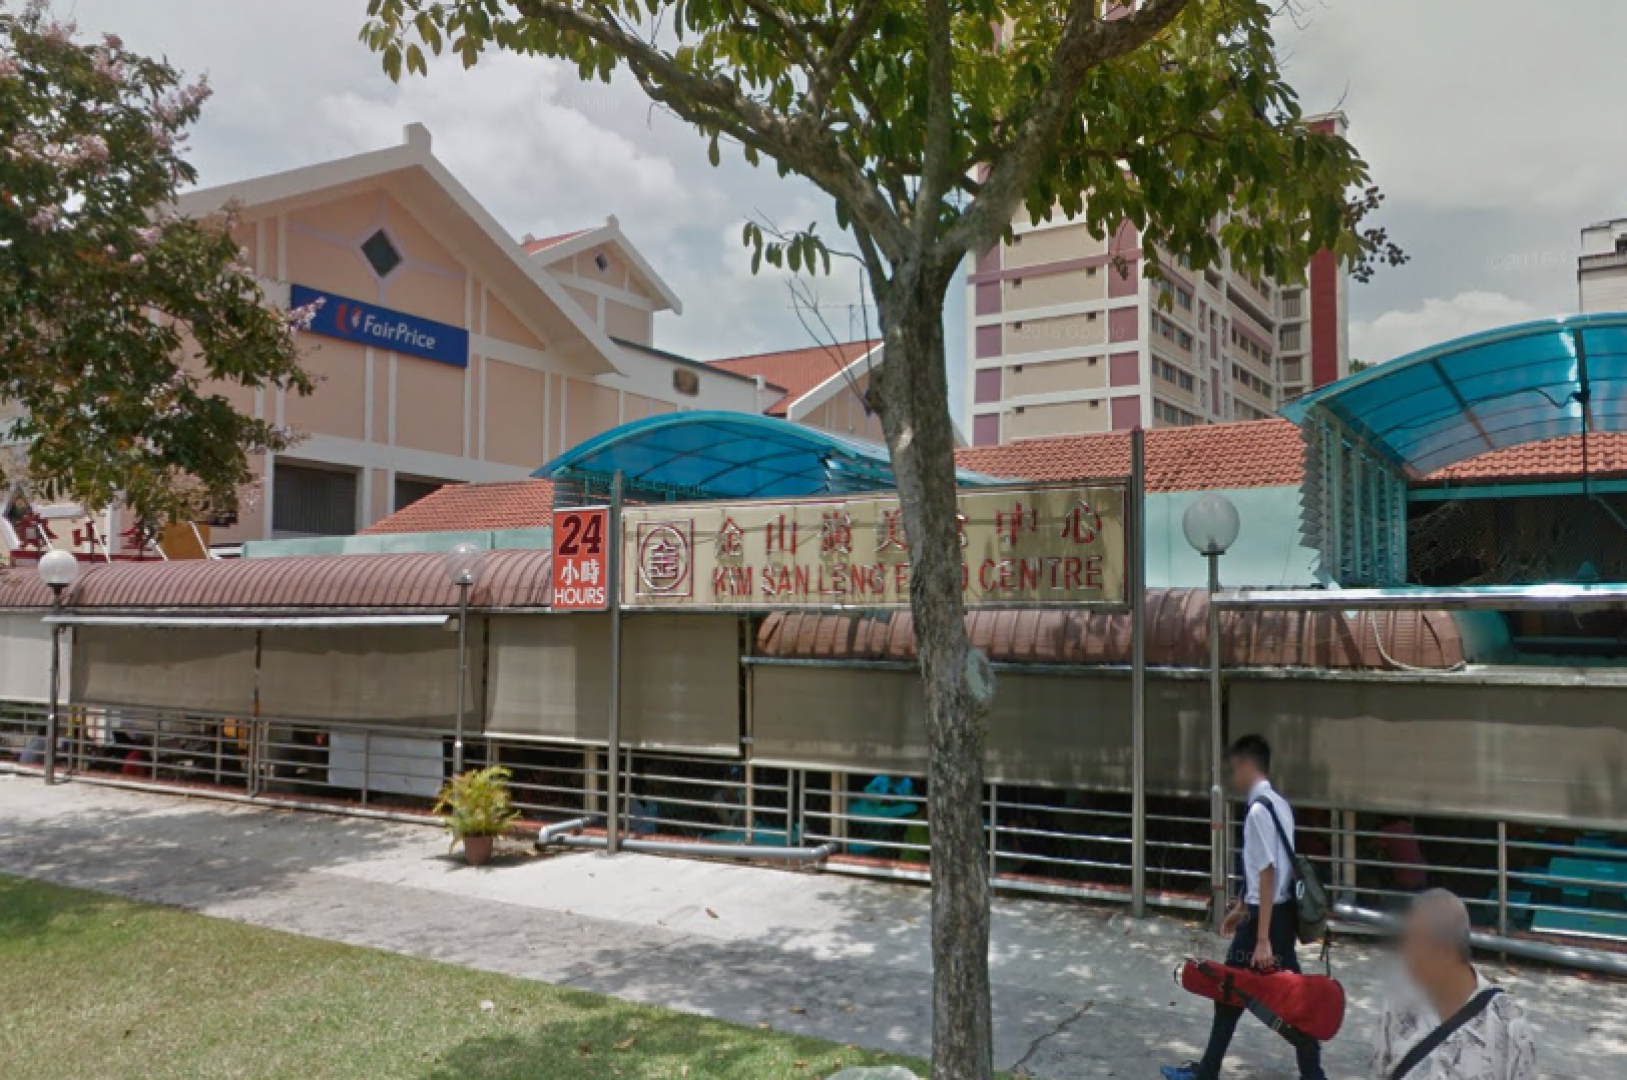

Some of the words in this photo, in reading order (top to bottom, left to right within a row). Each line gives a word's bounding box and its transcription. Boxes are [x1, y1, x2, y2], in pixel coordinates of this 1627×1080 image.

[364, 314, 436, 350] FairPrice
[558, 514, 602, 556] 24
[715, 499, 1103, 556] 金山嶺美中心
[561, 558, 600, 586] 小時
[713, 565, 753, 596] KIM
[761, 564, 810, 596] SAN
[818, 563, 885, 595] LENG
[978, 554, 1103, 592] CENTRE
[554, 587, 605, 605] HOURS
